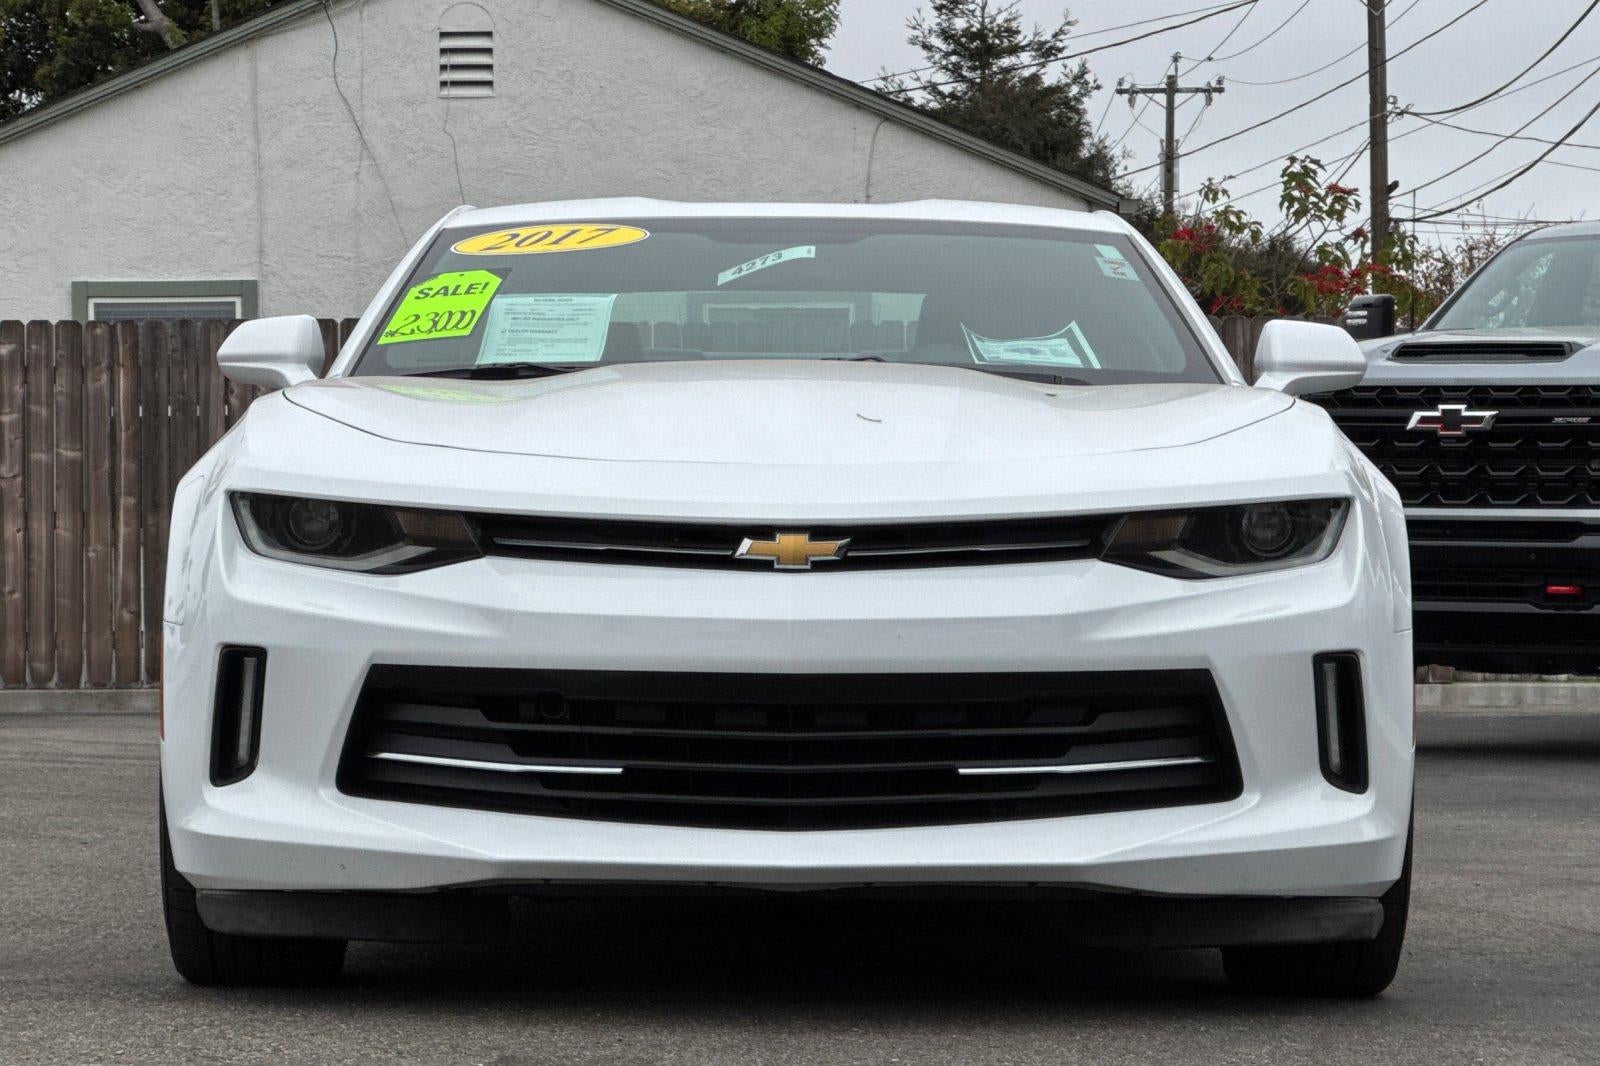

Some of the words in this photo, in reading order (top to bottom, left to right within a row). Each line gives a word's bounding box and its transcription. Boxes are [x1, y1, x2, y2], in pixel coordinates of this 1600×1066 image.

[479, 228, 622, 252] 2017
[731, 252, 783, 276] 4273
[414, 281, 490, 300] SALE!
